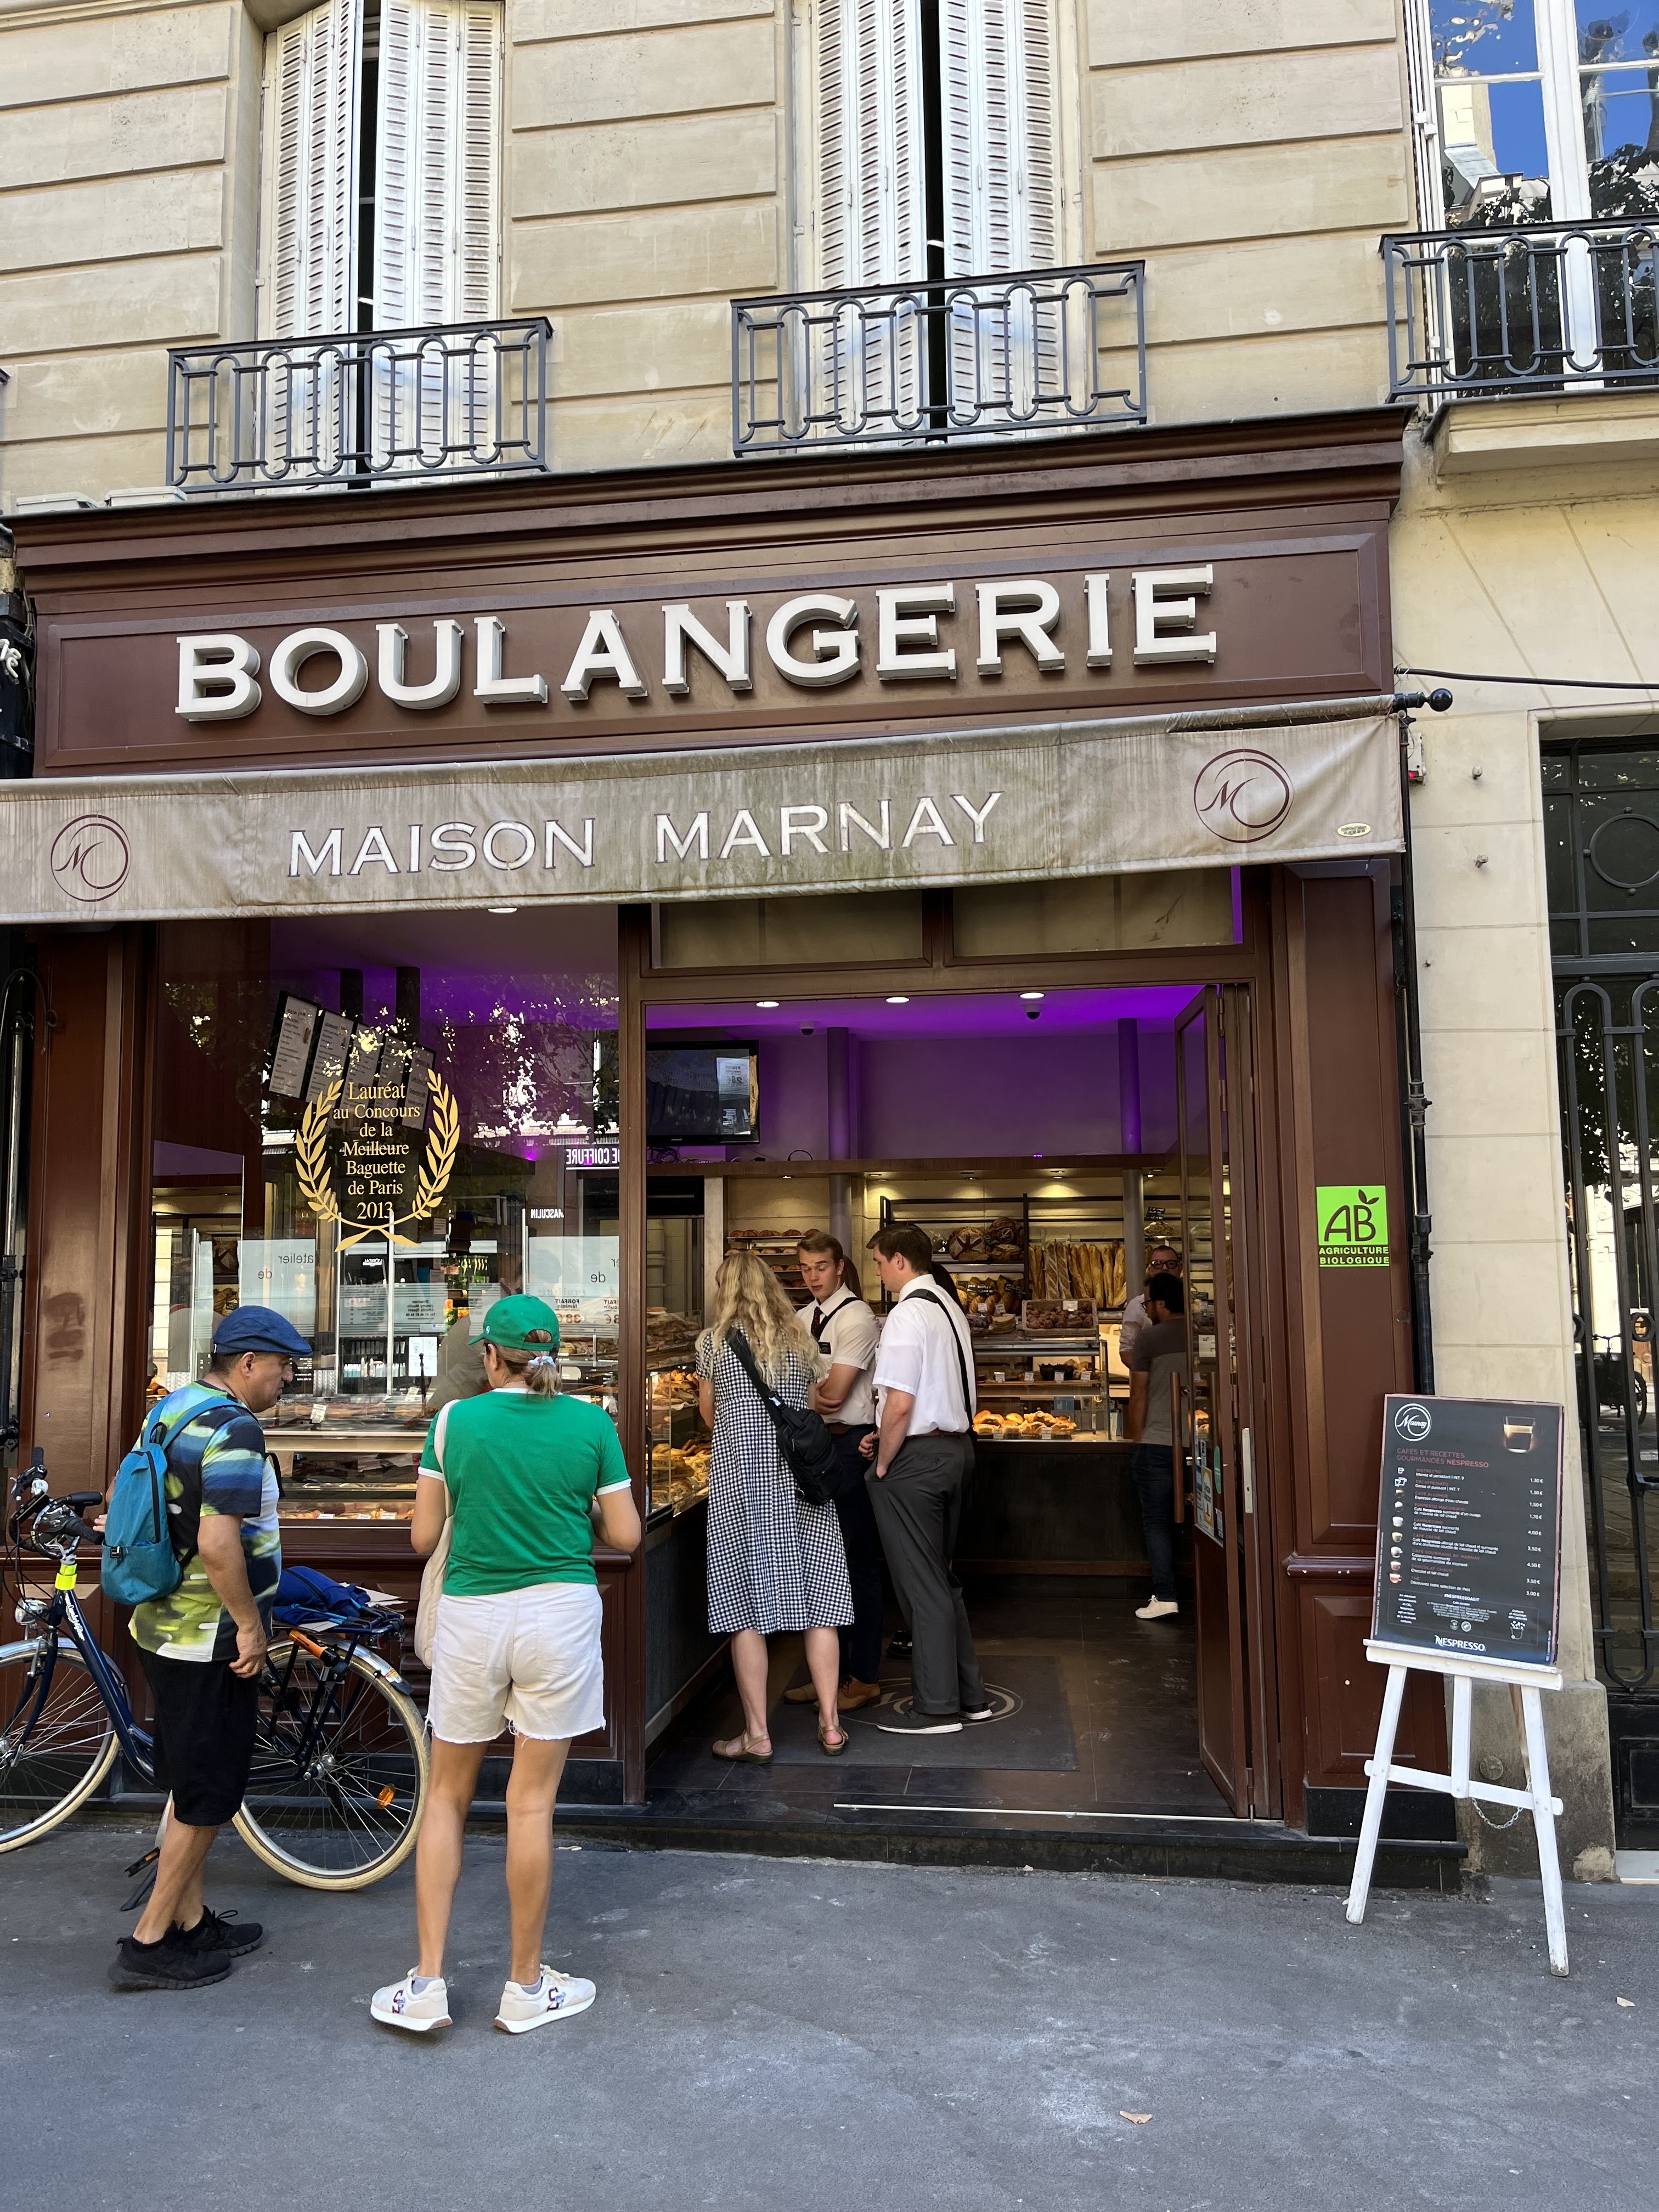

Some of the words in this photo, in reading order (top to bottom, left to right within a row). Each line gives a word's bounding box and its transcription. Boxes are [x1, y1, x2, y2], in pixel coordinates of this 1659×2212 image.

[174, 564, 1217, 721] BOULANGERIE
[287, 817, 595, 877] MAISON
[654, 791, 1003, 864] MARNAY
[348, 1081, 405, 1100] Lauréat
[333, 1107, 349, 1119] au
[354, 1104, 420, 1119] Concours
[359, 1122, 376, 1137] de
[381, 1122, 393, 1137] la
[343, 1141, 409, 1156] Meilleure
[346, 1160, 405, 1179] Baguette
[348, 1180, 365, 1195] de
[368, 1180, 403, 1194] Paris
[357, 1201, 393, 1220] 2013
[1324, 1205, 1376, 1242] AB
[1319, 1246, 1389, 1255] AGRICULTURE
[1396, 1455, 1444, 1464] GOURMANDES
[1447, 1459, 1489, 1468] NESPRESSO
[1435, 1635, 1486, 1651] NESPRESSO
